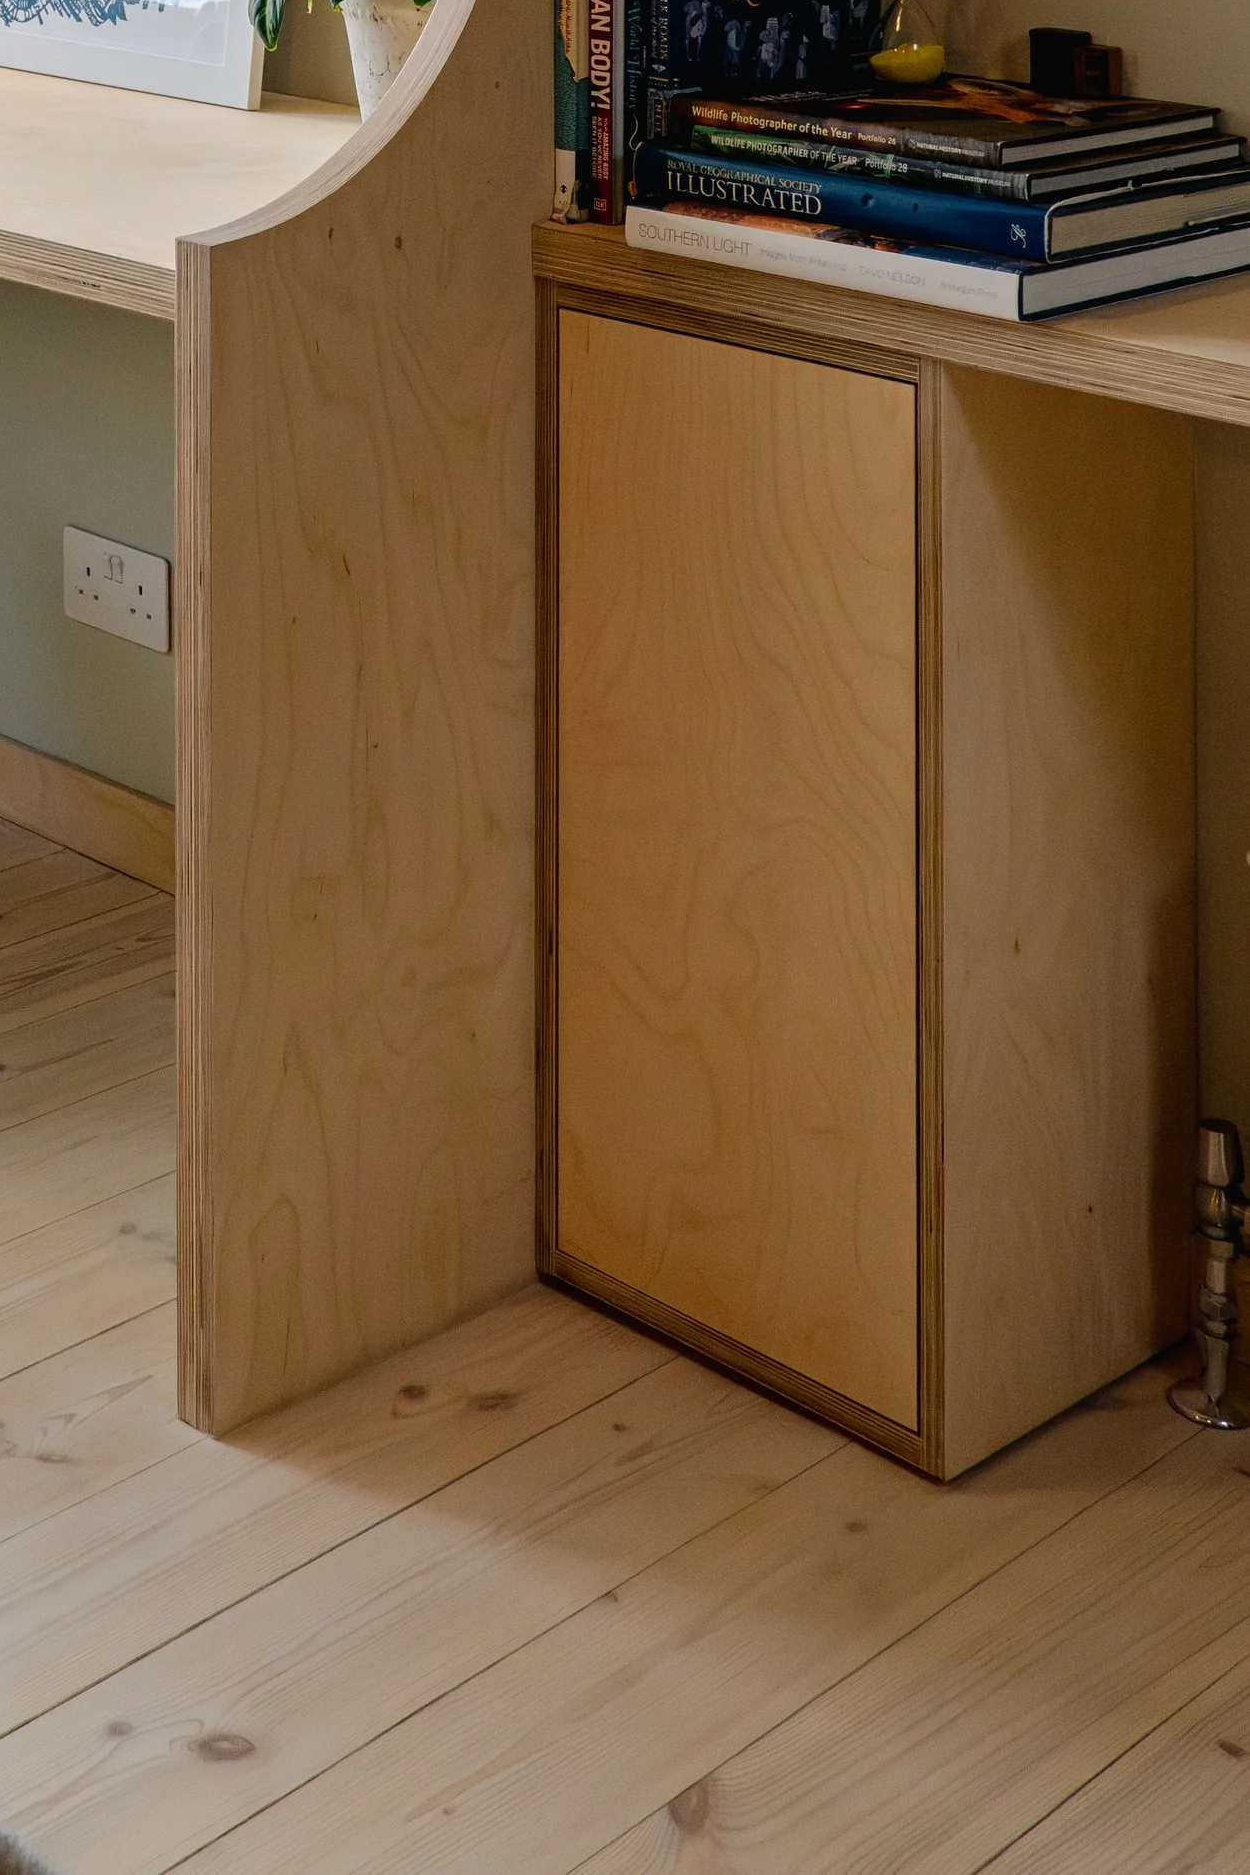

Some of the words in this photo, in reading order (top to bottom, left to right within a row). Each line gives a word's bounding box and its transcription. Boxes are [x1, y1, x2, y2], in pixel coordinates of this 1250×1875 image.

[627, 2, 642, 52] World
[659, 16, 669, 60] ROADS
[590, 37, 611, 110] BODY!
[692, 104, 728, 123] Wildlife
[730, 109, 797, 138] Photographer
[798, 120, 811, 135] of
[810, 122, 829, 137] the
[830, 124, 852, 140] Year
[857, 132, 886, 145] Portfolio
[939, 145, 962, 155] HISTORY
[667, 157, 699, 173] ROYAL
[699, 162, 777, 187] GEOGRAPHICAL
[778, 178, 823, 195] SOCIETY
[710, 134, 746, 150] WILDLIFE
[746, 138, 809, 159] PHOTOGRAPHER
[809, 146, 820, 159] OF
[820, 148, 833, 161] THE
[833, 150, 858, 165] YEAR
[864, 157, 896, 173] Portfolio
[897, 162, 908, 174] 28
[964, 175, 988, 185] HISTORY
[666, 171, 823, 217] ILLUSTRATED
[637, 221, 710, 252] SOUTHERN
[713, 234, 753, 256] LIGHT
